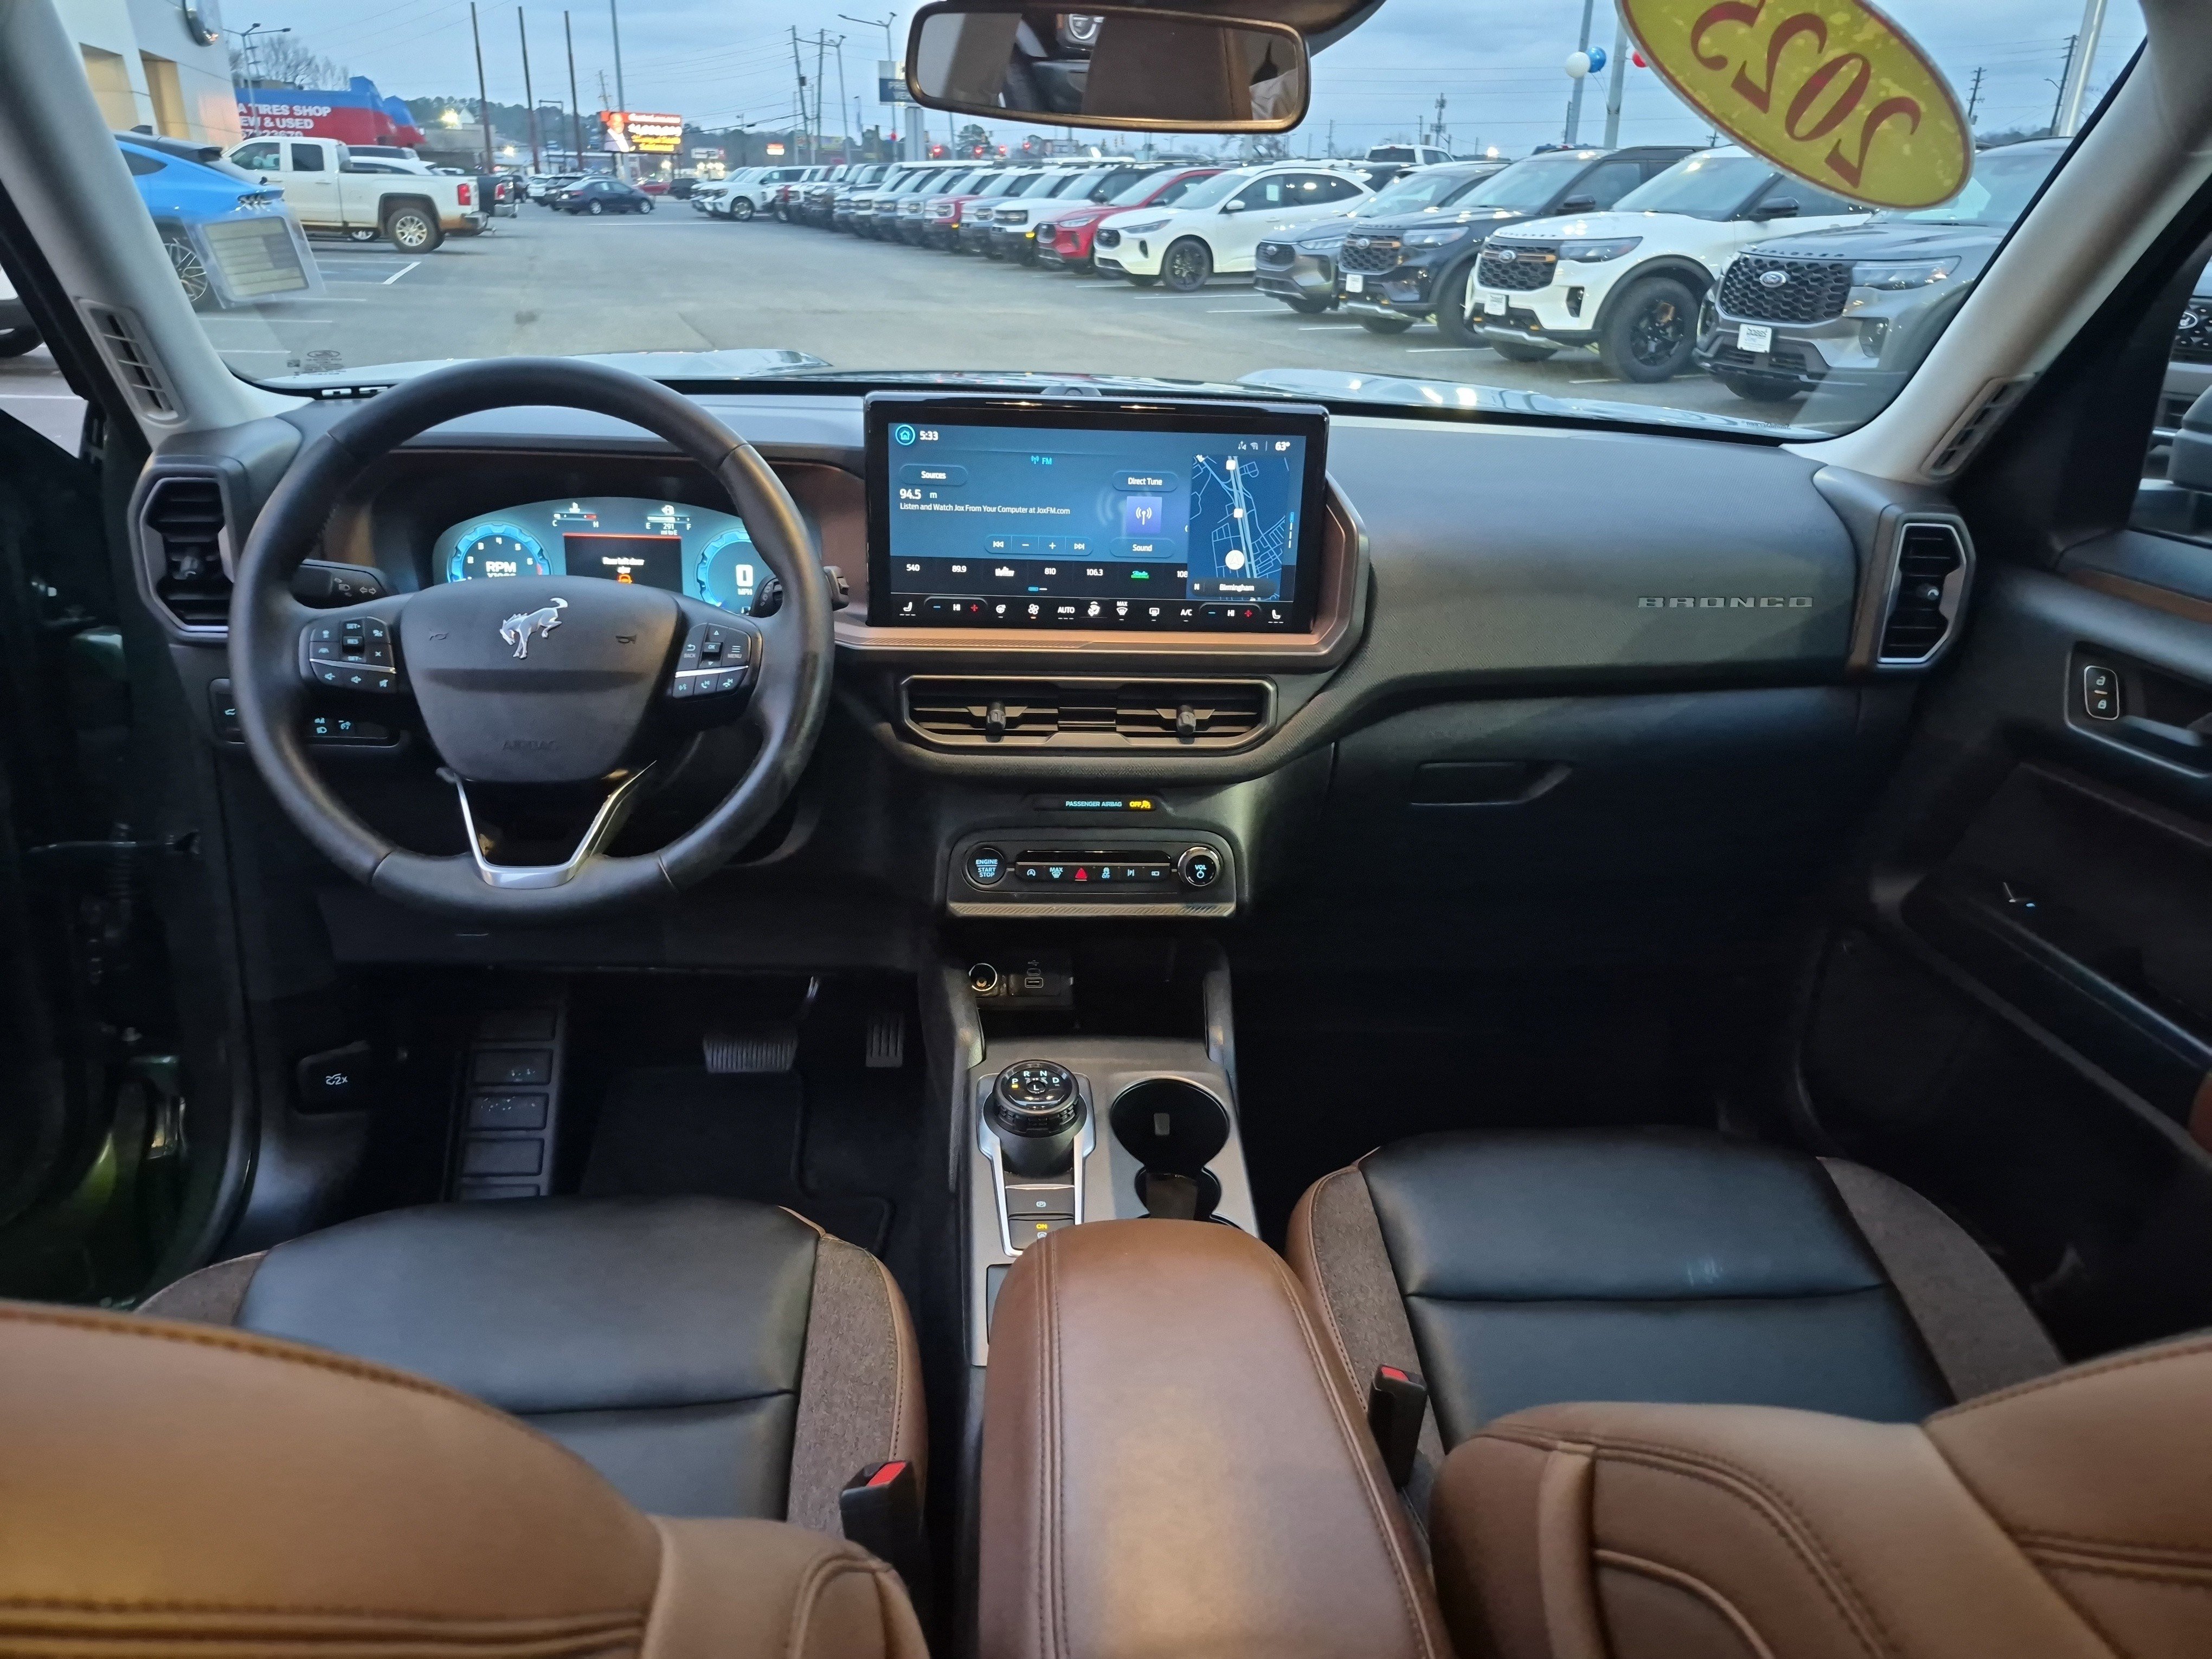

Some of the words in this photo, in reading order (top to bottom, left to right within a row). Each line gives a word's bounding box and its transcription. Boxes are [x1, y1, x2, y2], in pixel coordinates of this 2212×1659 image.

[292, 105, 332, 117] SHOP
[263, 117, 275, 127] &
[275, 118, 314, 129] USED
[919, 430, 938, 441] 5:33
[921, 471, 947, 479] Sources
[1128, 477, 1146, 485] Direct
[1147, 478, 1162, 486] Tune
[899, 488, 921, 499] 94.5
[933, 503, 953, 511] Watch
[997, 506, 1028, 514] Computer
[1132, 544, 1153, 552] Sound
[486, 561, 517, 573] RPM
[736, 564, 754, 587] 0
[1219, 583, 1255, 592] Birmingham
[1637, 597, 1812, 608] BRONCO
